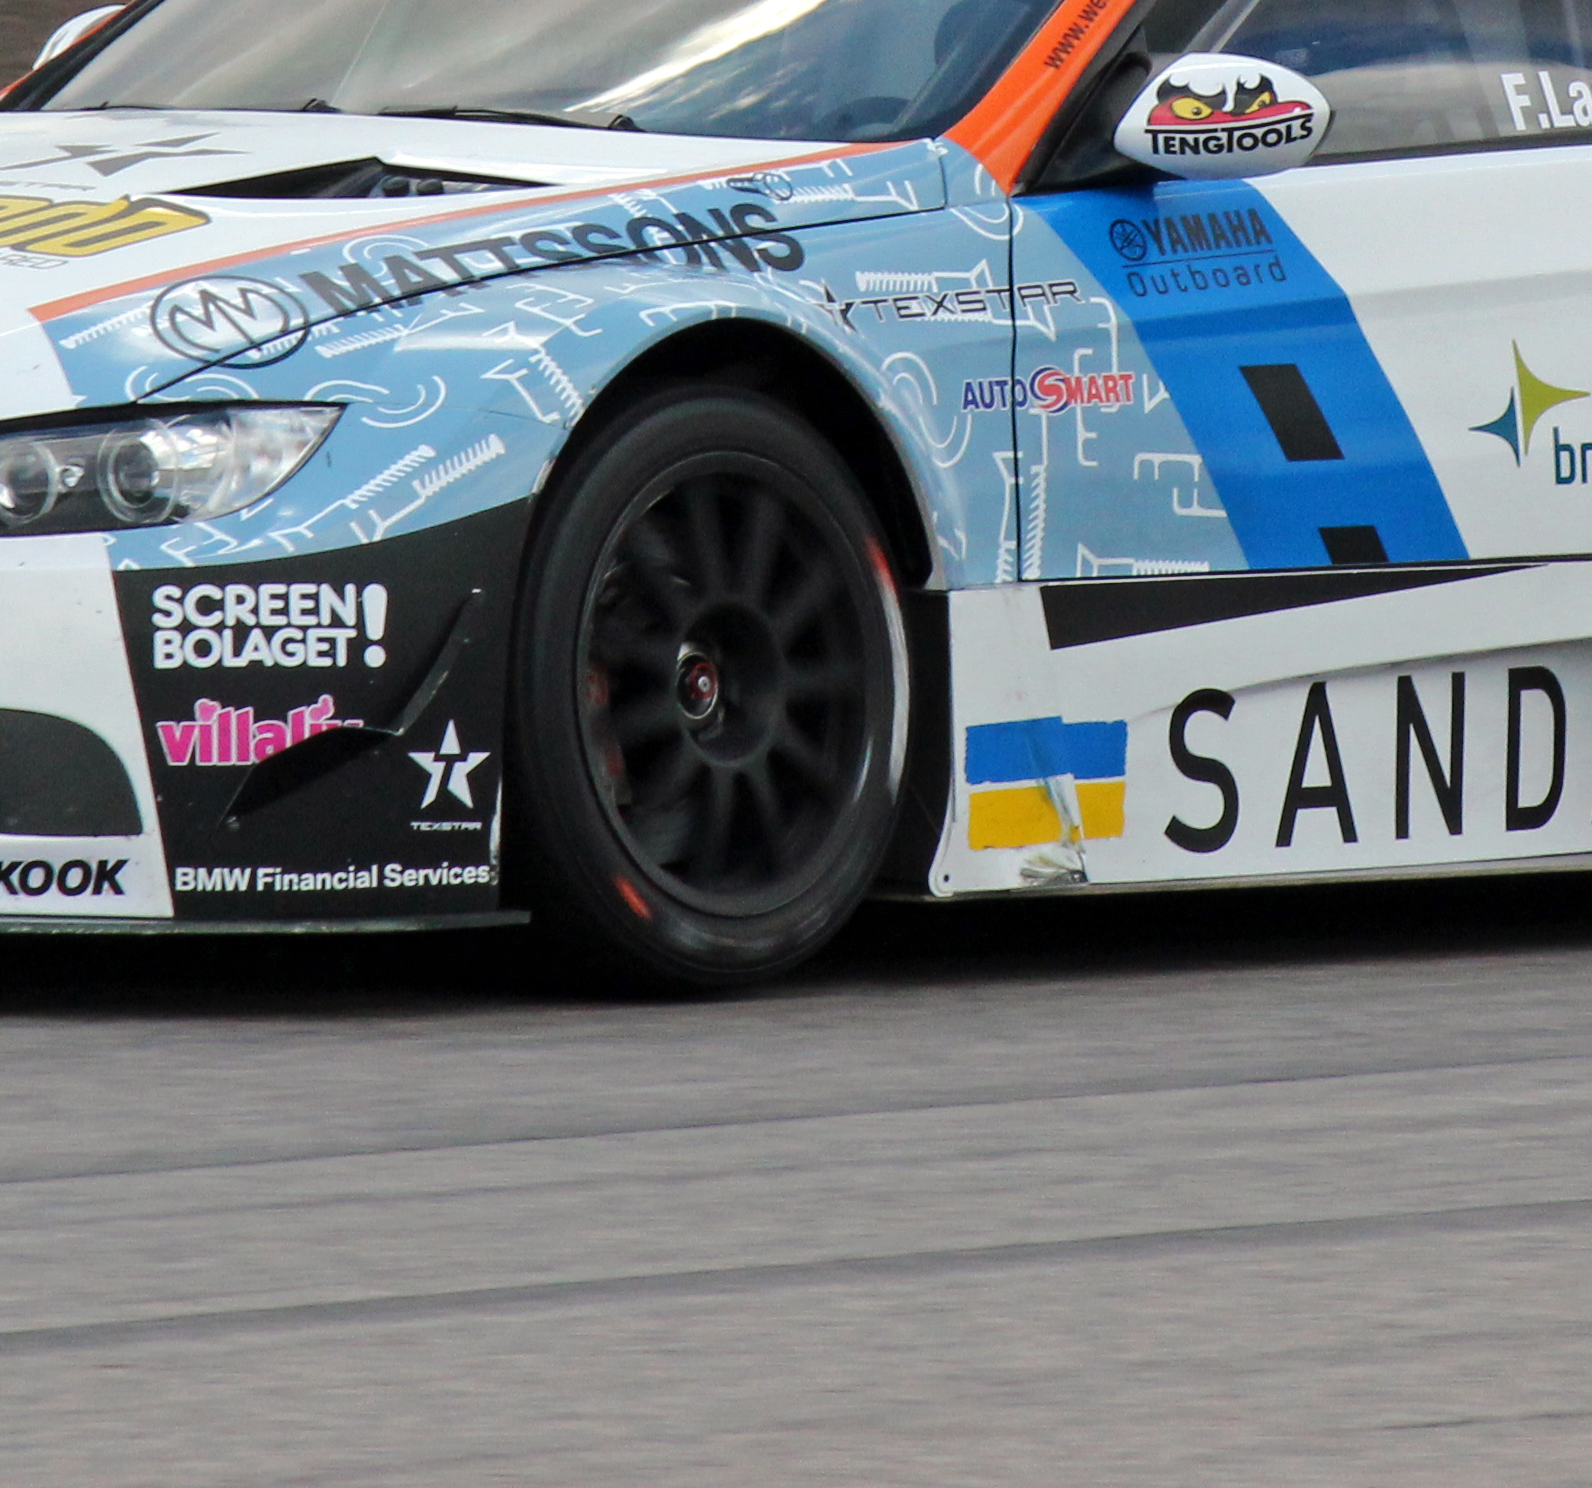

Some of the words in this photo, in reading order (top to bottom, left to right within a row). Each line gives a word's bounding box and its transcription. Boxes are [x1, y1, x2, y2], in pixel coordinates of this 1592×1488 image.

[1145, 114, 1314, 155] TENGTOOLS
[1142, 207, 1274, 259] YAMAHA
[300, 204, 804, 316] MATTSSONS
[1128, 255, 1287, 298] Outboard
[859, 280, 1084, 323] TEXSTAR
[151, 583, 357, 628] SCREEN
[153, 628, 357, 669] BOLAGET
[410, 821, 483, 831] TEXSTAR
[175, 867, 251, 892] BMW
[256, 864, 379, 891] Financial
[383, 863, 491, 888] Services
